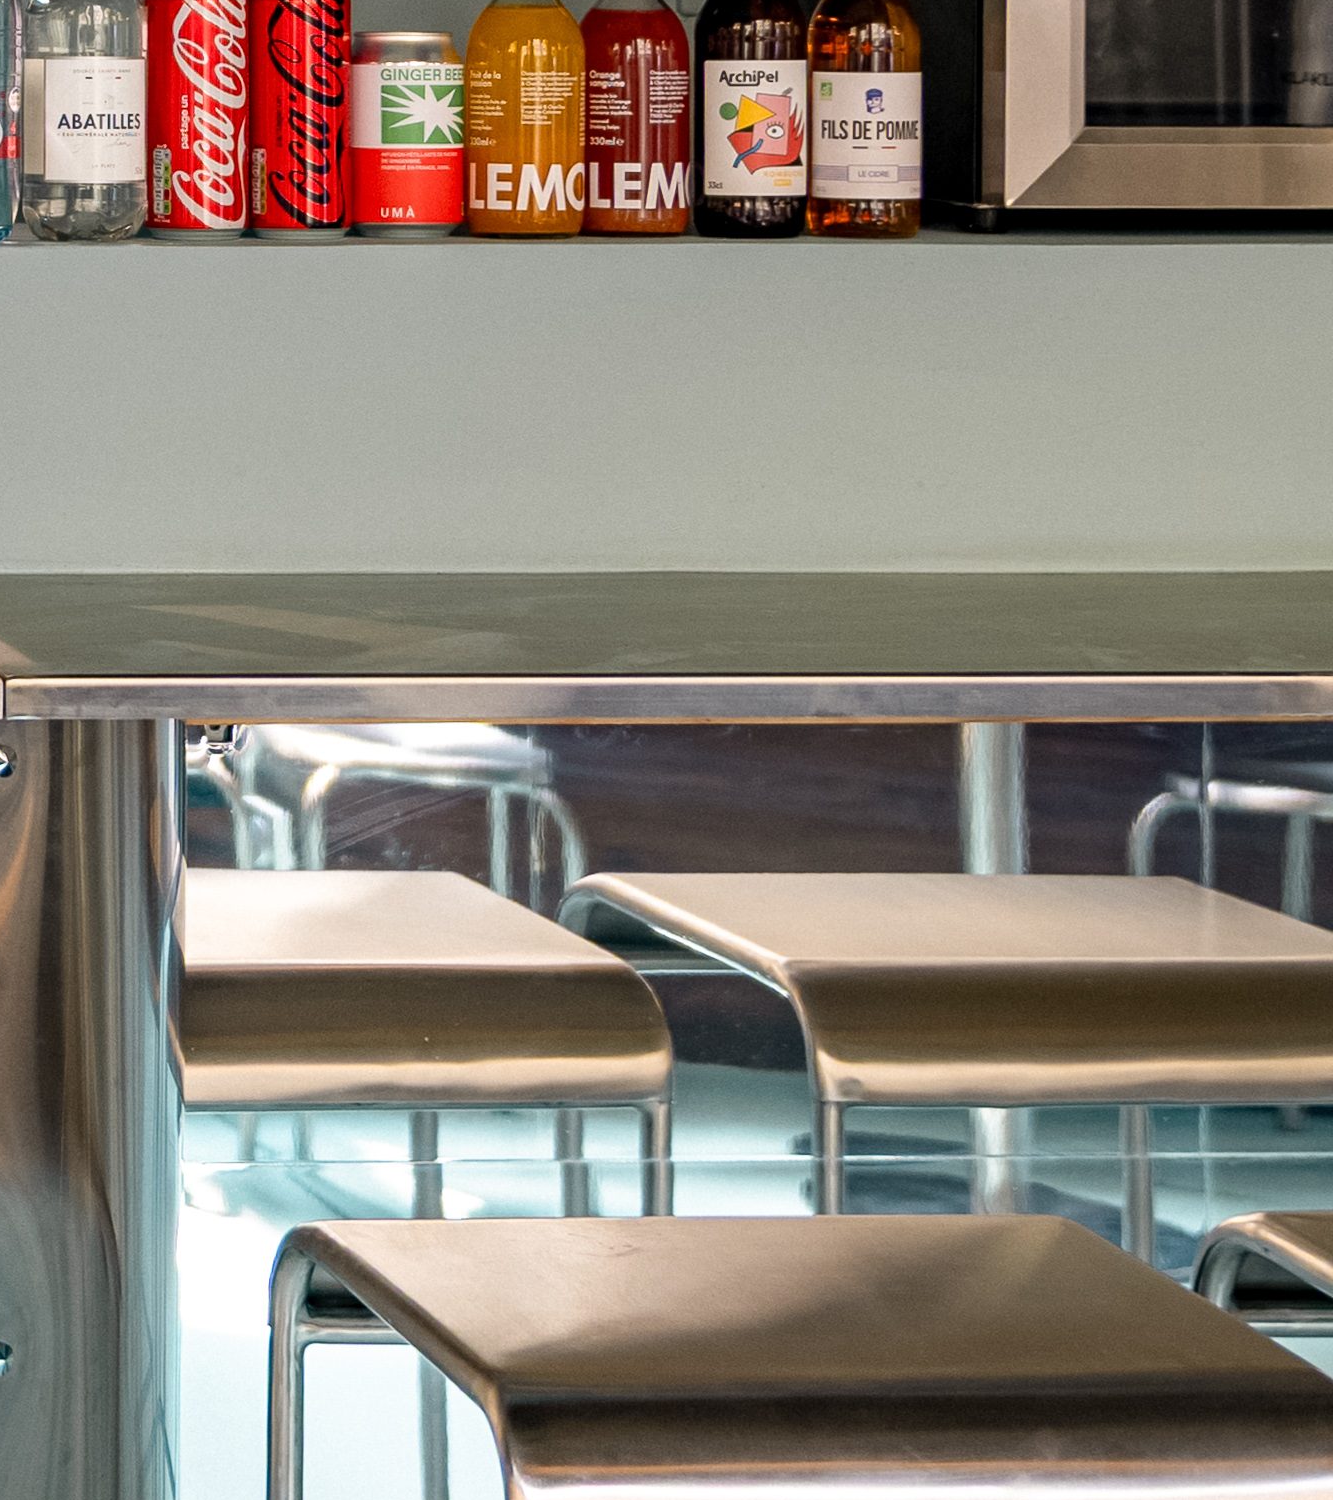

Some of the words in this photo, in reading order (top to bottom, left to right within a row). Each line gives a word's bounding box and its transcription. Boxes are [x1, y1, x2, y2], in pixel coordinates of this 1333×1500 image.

[380, 68, 442, 81] GINGER
[589, 70, 621, 81] Orange
[719, 70, 779, 86] ArchiPel
[180, 95, 189, 108] un
[57, 113, 141, 130] ABATILLES
[821, 120, 848, 140] FILS
[852, 120, 872, 140] DE
[876, 120, 919, 140] POMME
[589, 162, 694, 210] LEM
[380, 205, 416, 218] UMÀ
